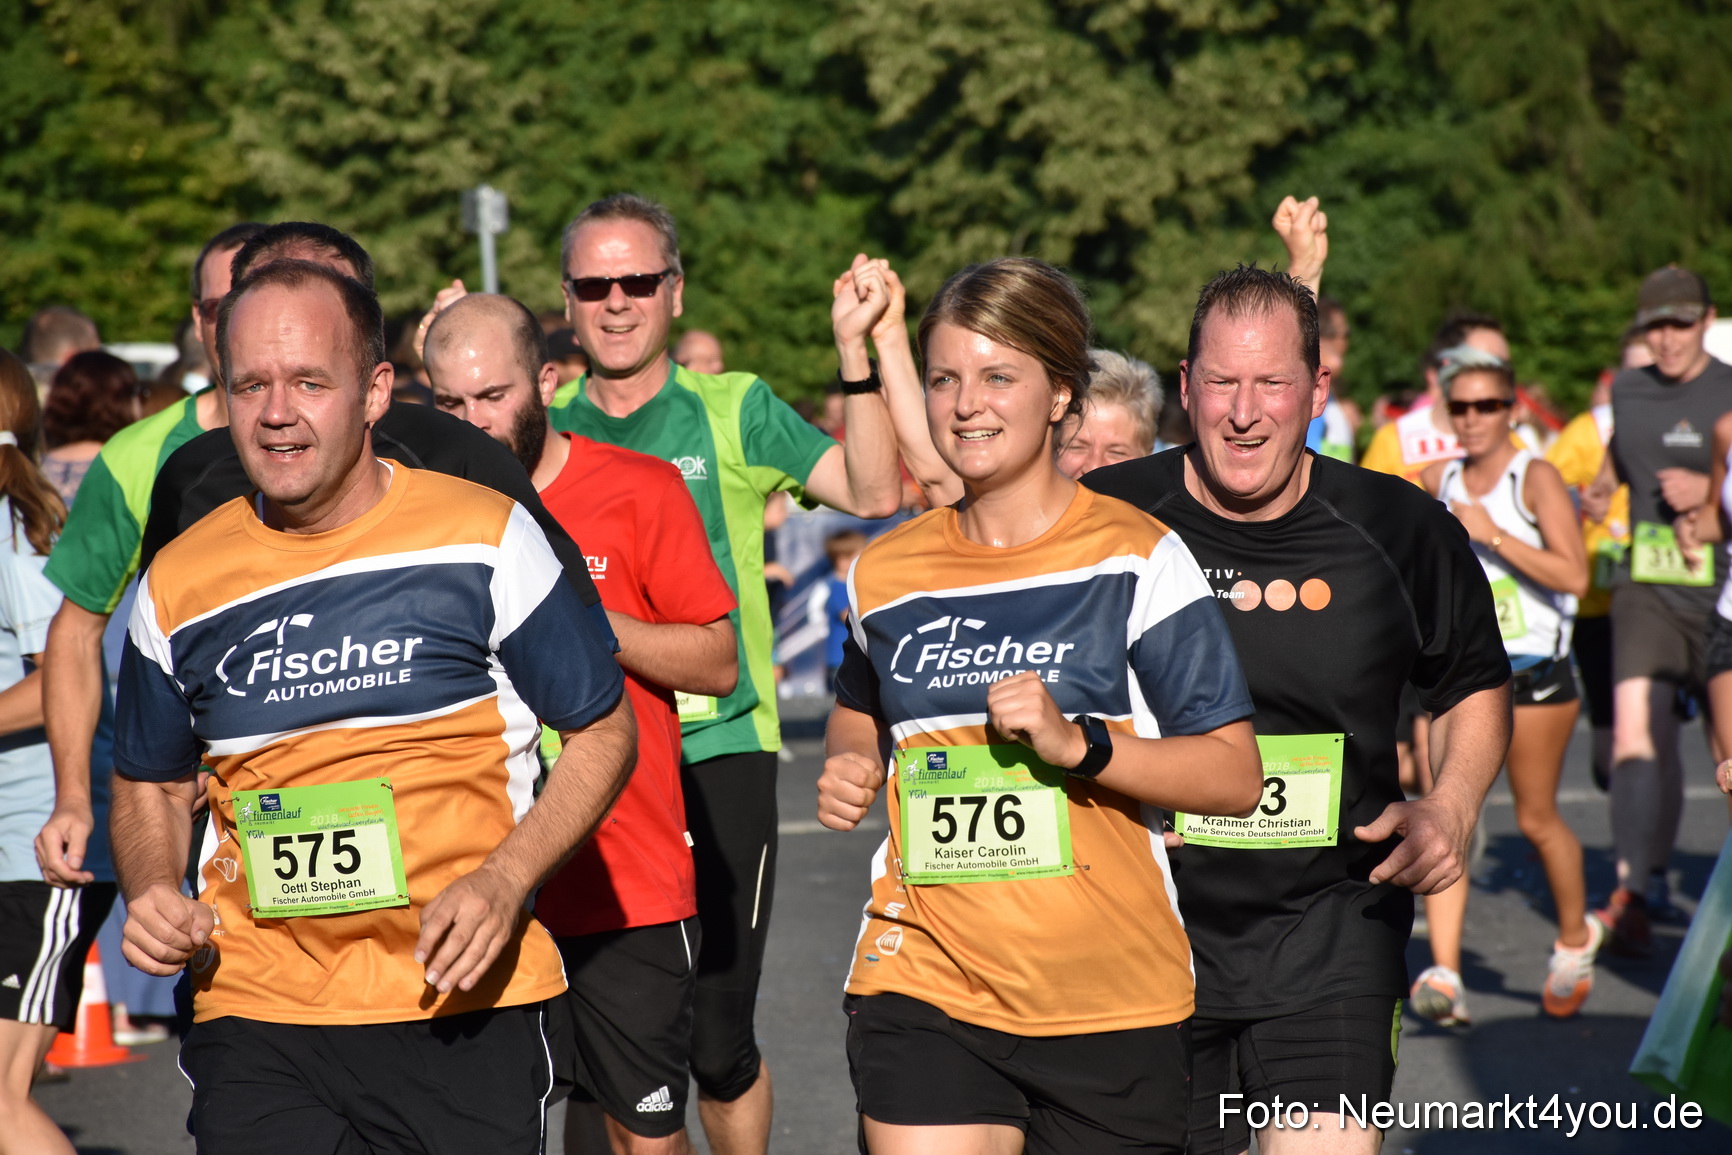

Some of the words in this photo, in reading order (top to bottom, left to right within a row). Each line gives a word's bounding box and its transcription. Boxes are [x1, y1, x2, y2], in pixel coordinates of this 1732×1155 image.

[1216, 589, 1245, 599] Team
[247, 635, 423, 685] Fischer
[915, 635, 1075, 673] Fischer
[263, 668, 412, 704] AUTOMOBILE
[927, 669, 1061, 690] AUTOMOE
[918, 766, 967, 780] firmenlauf
[1262, 762, 1290, 771] 2018
[974, 776, 1004, 788] 2018
[253, 806, 302, 821] firmenlauf
[310, 813, 339, 826] 2018
[931, 793, 1026, 844] 576
[1202, 815, 1255, 829] Krahmer
[1258, 818, 1311, 828] Christian
[1186, 825, 1208, 834] Aptiv
[1210, 828, 1246, 837] Services
[1247, 829, 1298, 838] Deutschland
[1299, 828, 1325, 836] GmbH
[272, 828, 362, 881] 575
[934, 847, 974, 859] Kaiser
[977, 844, 1026, 858] Carolin
[925, 861, 955, 870] Fischer
[956, 859, 1007, 869] Automobile
[1009, 857, 1039, 867] GmbH
[281, 880, 308, 895] Oettl
[310, 876, 362, 894] Stephan
[272, 895, 299, 905] Fischer
[301, 892, 346, 904] Automobile
[348, 888, 376, 899] GmbH
[636, 1101, 674, 1112] adidas
